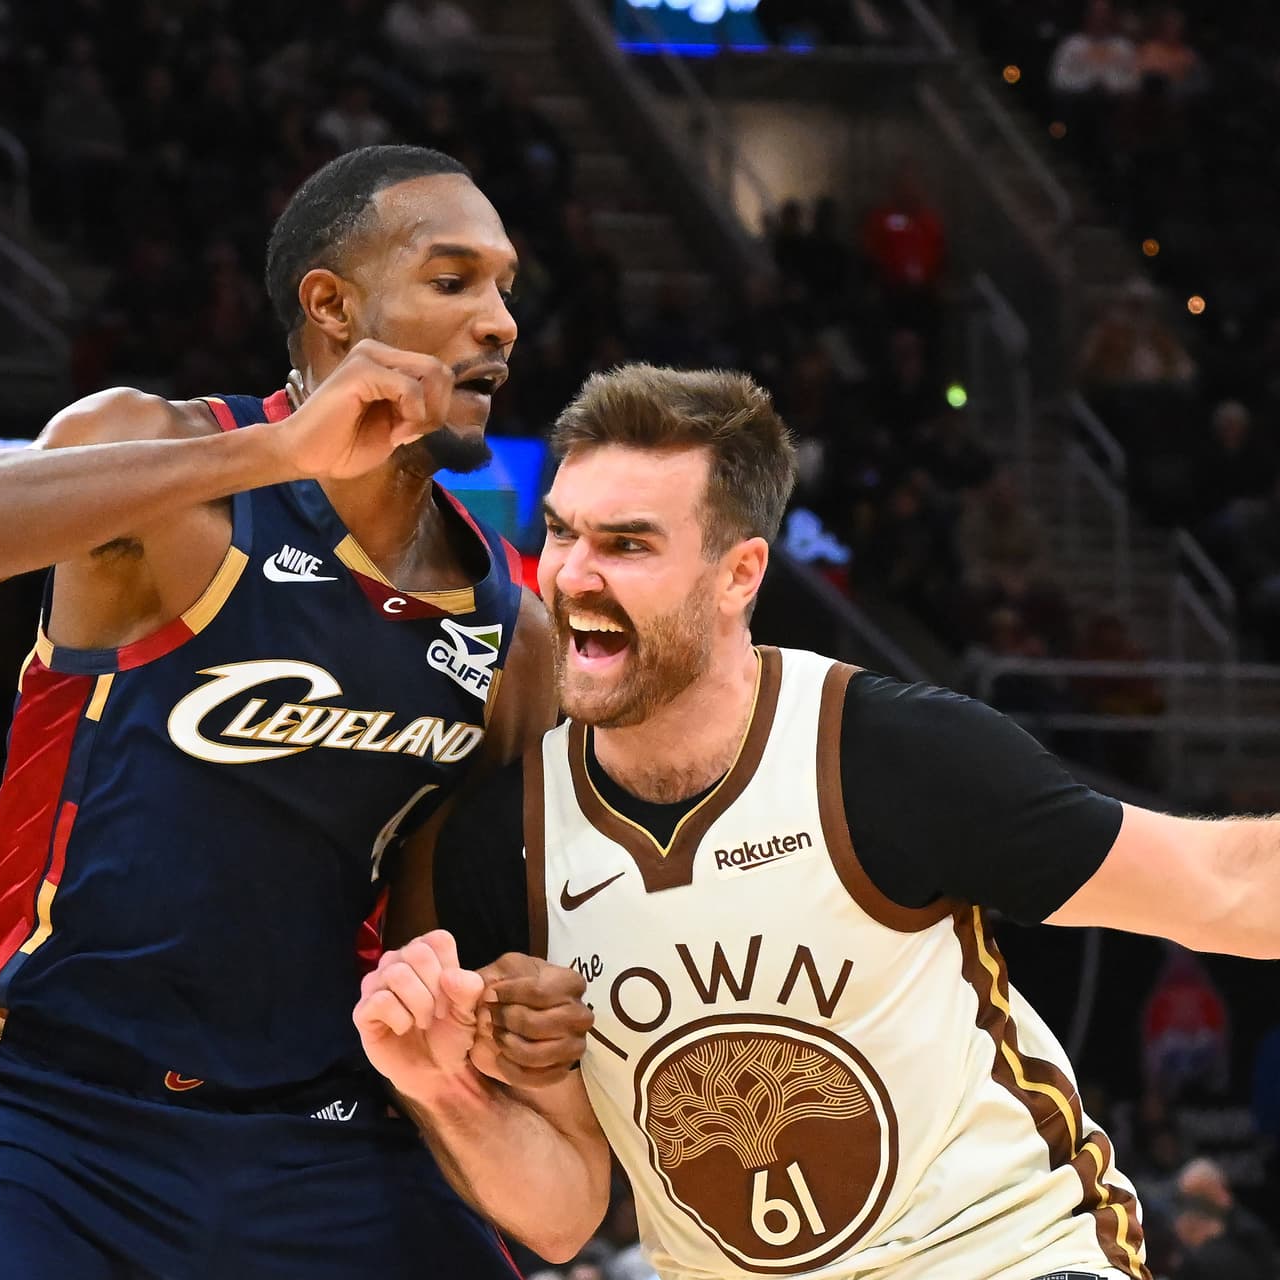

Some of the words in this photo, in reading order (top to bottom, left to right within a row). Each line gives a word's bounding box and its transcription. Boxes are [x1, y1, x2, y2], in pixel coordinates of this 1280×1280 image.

[276, 545, 323, 577] NIKE
[168, 658, 485, 764] CLEVELAND
[714, 831, 813, 870] Rakuten
[751, 1161, 826, 1246] 61
